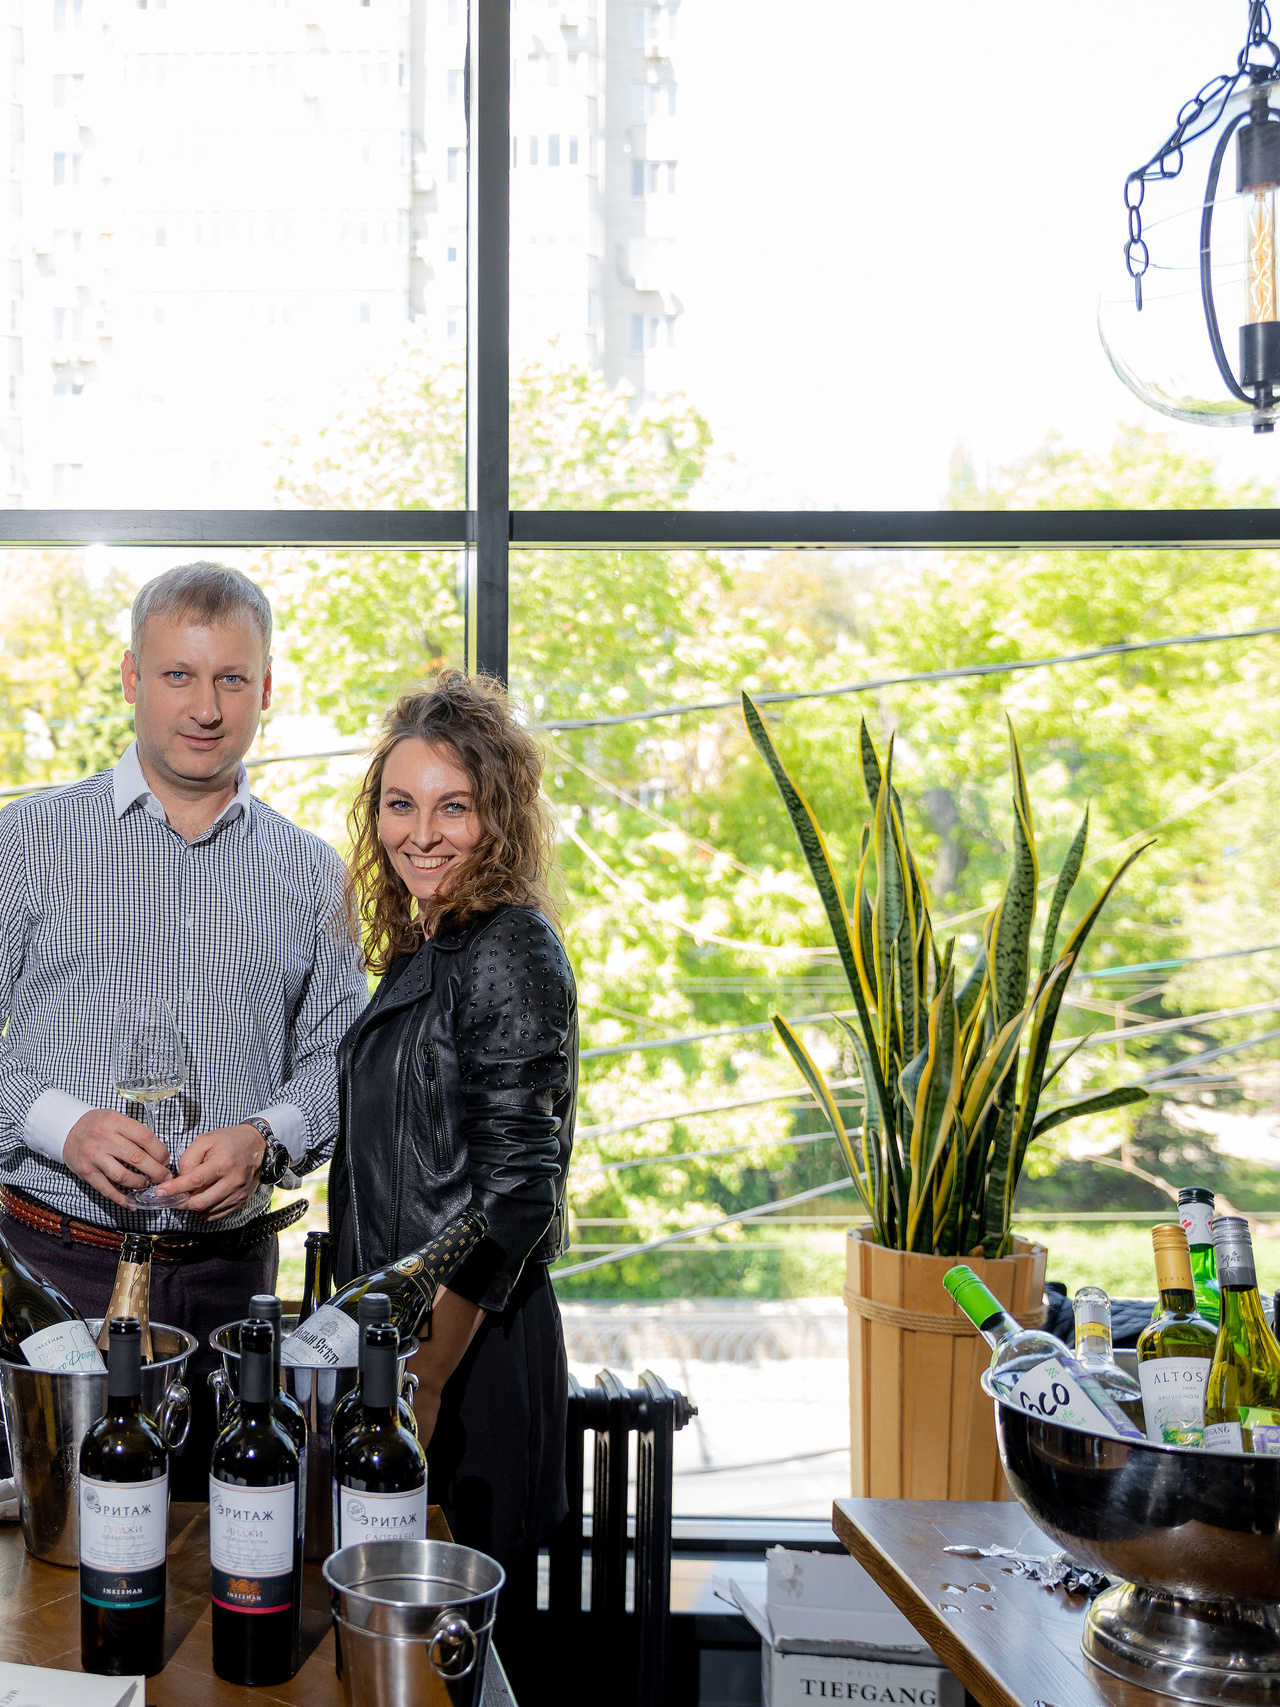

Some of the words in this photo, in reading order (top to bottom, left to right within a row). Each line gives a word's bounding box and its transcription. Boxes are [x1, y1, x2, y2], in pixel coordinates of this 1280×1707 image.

[1153, 1371, 1204, 1385] ALTOS
[94, 1503, 152, 1516] ЭРИТАЖ
[218, 1504, 274, 1521] ЭРИТАЖ
[360, 1512, 417, 1527] ЭРИТАЖ
[104, 1525, 143, 1535] ГУРДЖИ
[226, 1526, 263, 1538] ИНДЖИ
[102, 1587, 143, 1595] INKERMAN
[226, 1591, 262, 1601] INKERMAN
[799, 1678, 937, 1706] TIEFGANG
